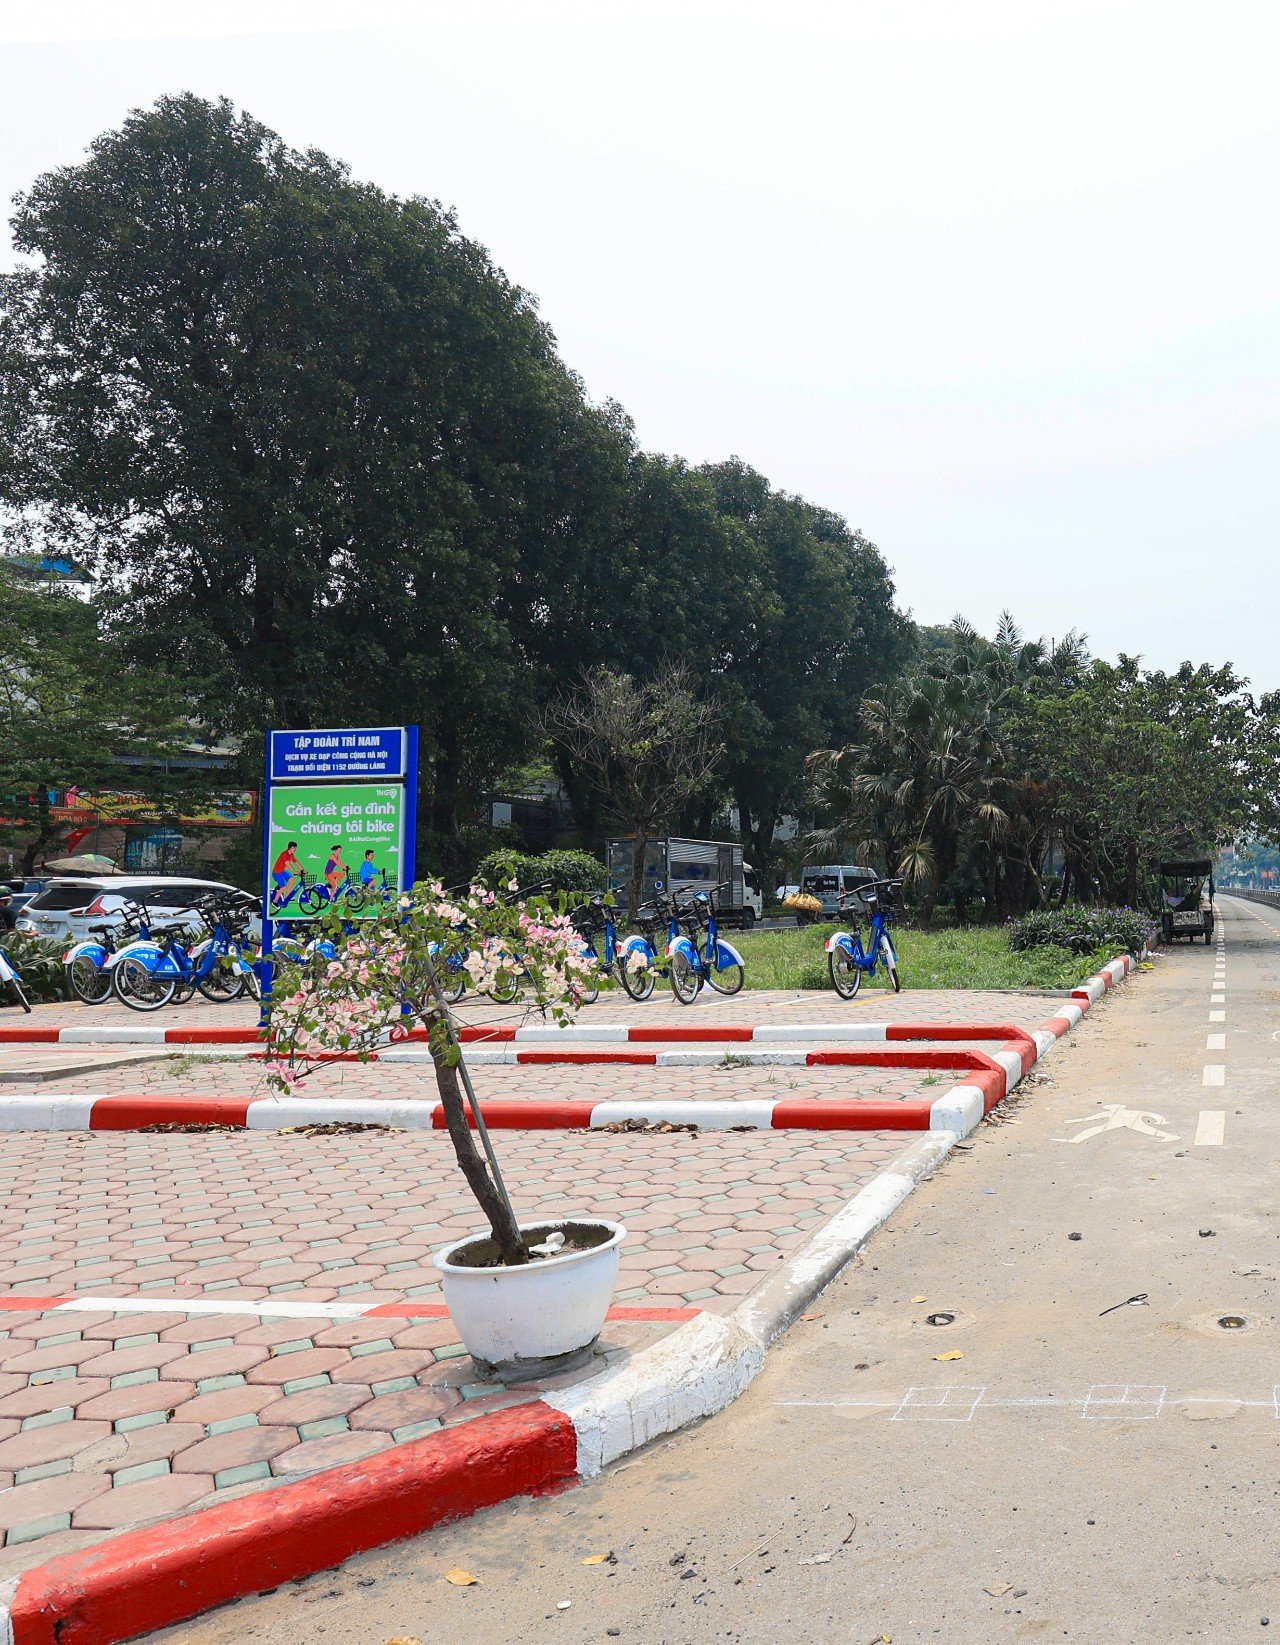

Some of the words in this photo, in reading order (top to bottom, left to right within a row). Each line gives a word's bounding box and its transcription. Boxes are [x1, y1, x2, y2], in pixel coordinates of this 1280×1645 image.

[294, 736, 311, 750] TẬP
[313, 735, 339, 748] ĐOÀN
[341, 735, 356, 747] TRÍ
[358, 736, 380, 747] NAM
[350, 751, 366, 760] CỘNG
[377, 750, 388, 759] NỘI
[369, 762, 386, 770] LÁNG
[286, 802, 312, 817] Gắn
[316, 802, 337, 816] kết
[341, 802, 361, 818] gia
[365, 802, 395, 815] đình
[301, 821, 342, 835] chúng
[346, 821, 362, 833] tôi
[367, 820, 395, 832] bike
